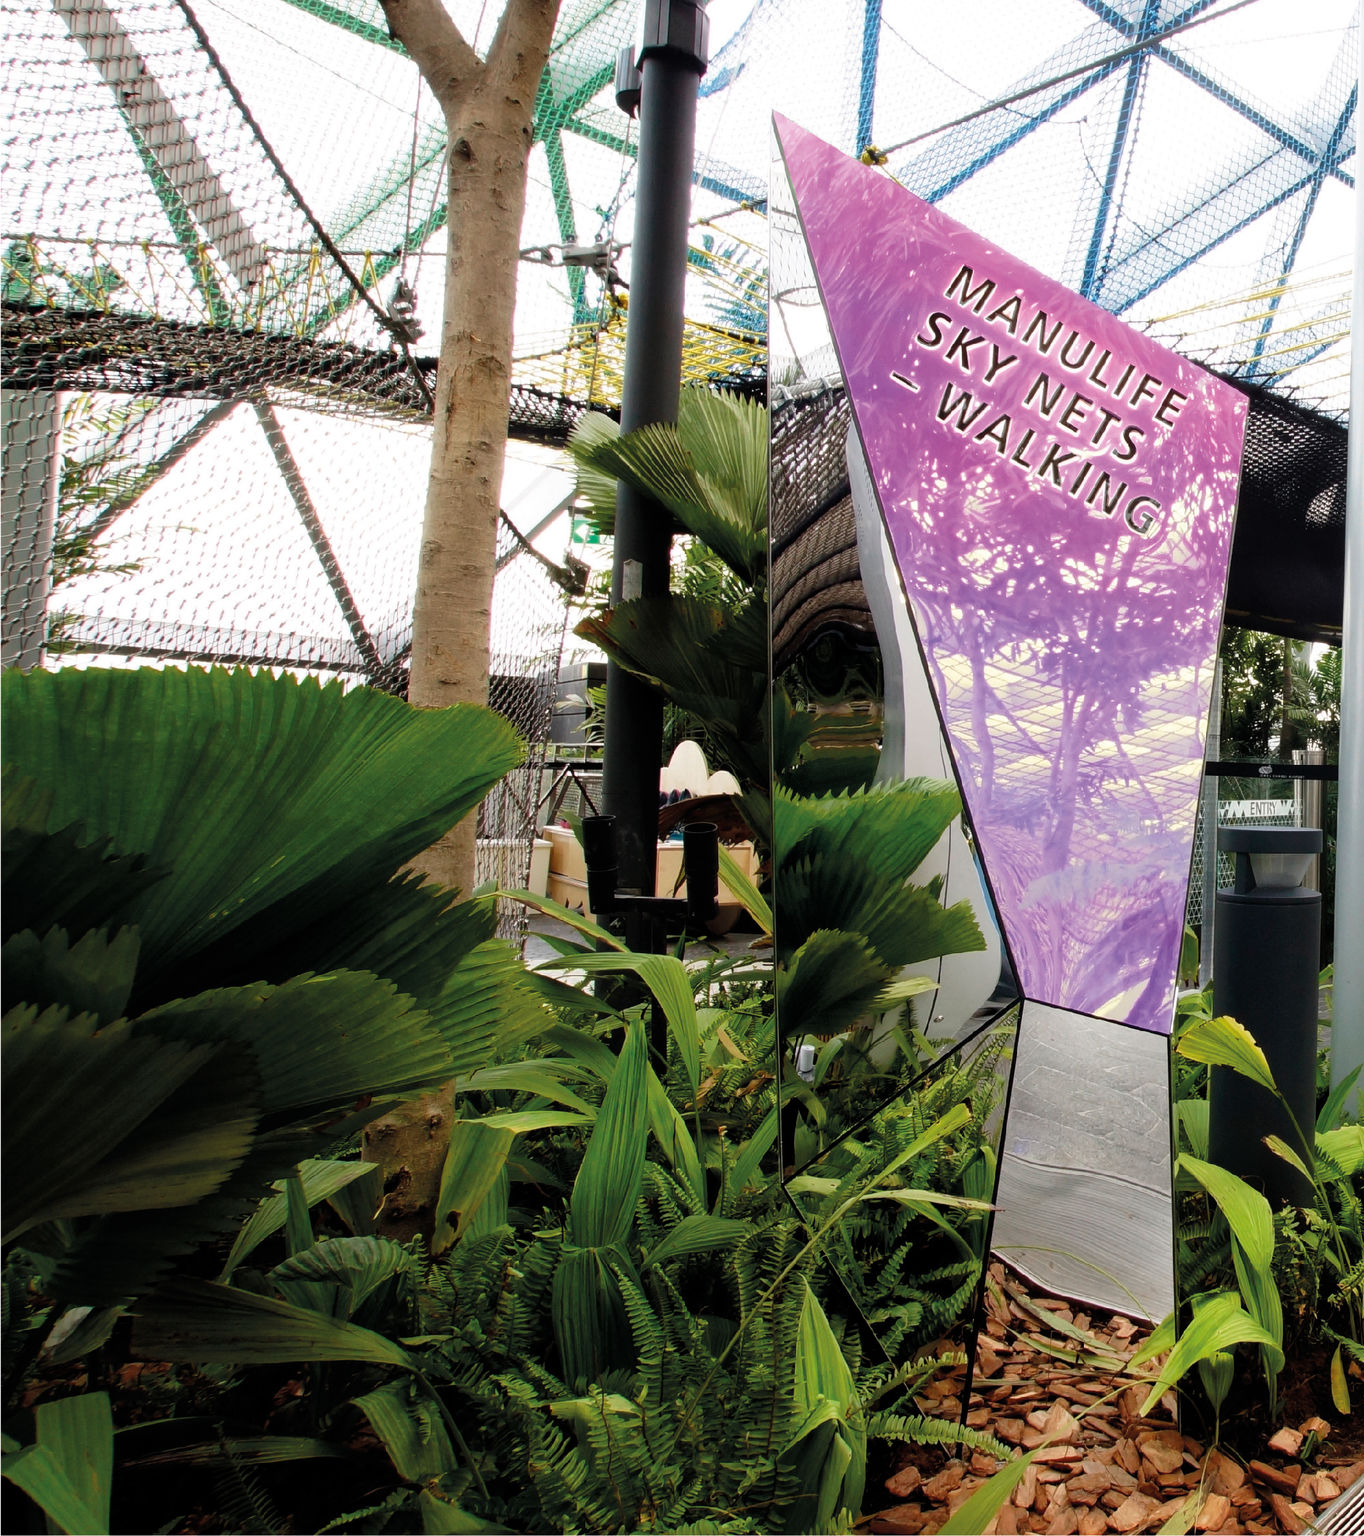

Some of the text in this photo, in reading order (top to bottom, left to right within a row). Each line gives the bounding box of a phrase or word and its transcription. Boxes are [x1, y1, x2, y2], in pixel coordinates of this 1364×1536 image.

[916, 311, 1145, 461] SKY NETS
[944, 264, 1189, 428] MANULIFE
[936, 381, 1162, 535] WALKING
[1250, 801, 1277, 816] ENTRY
